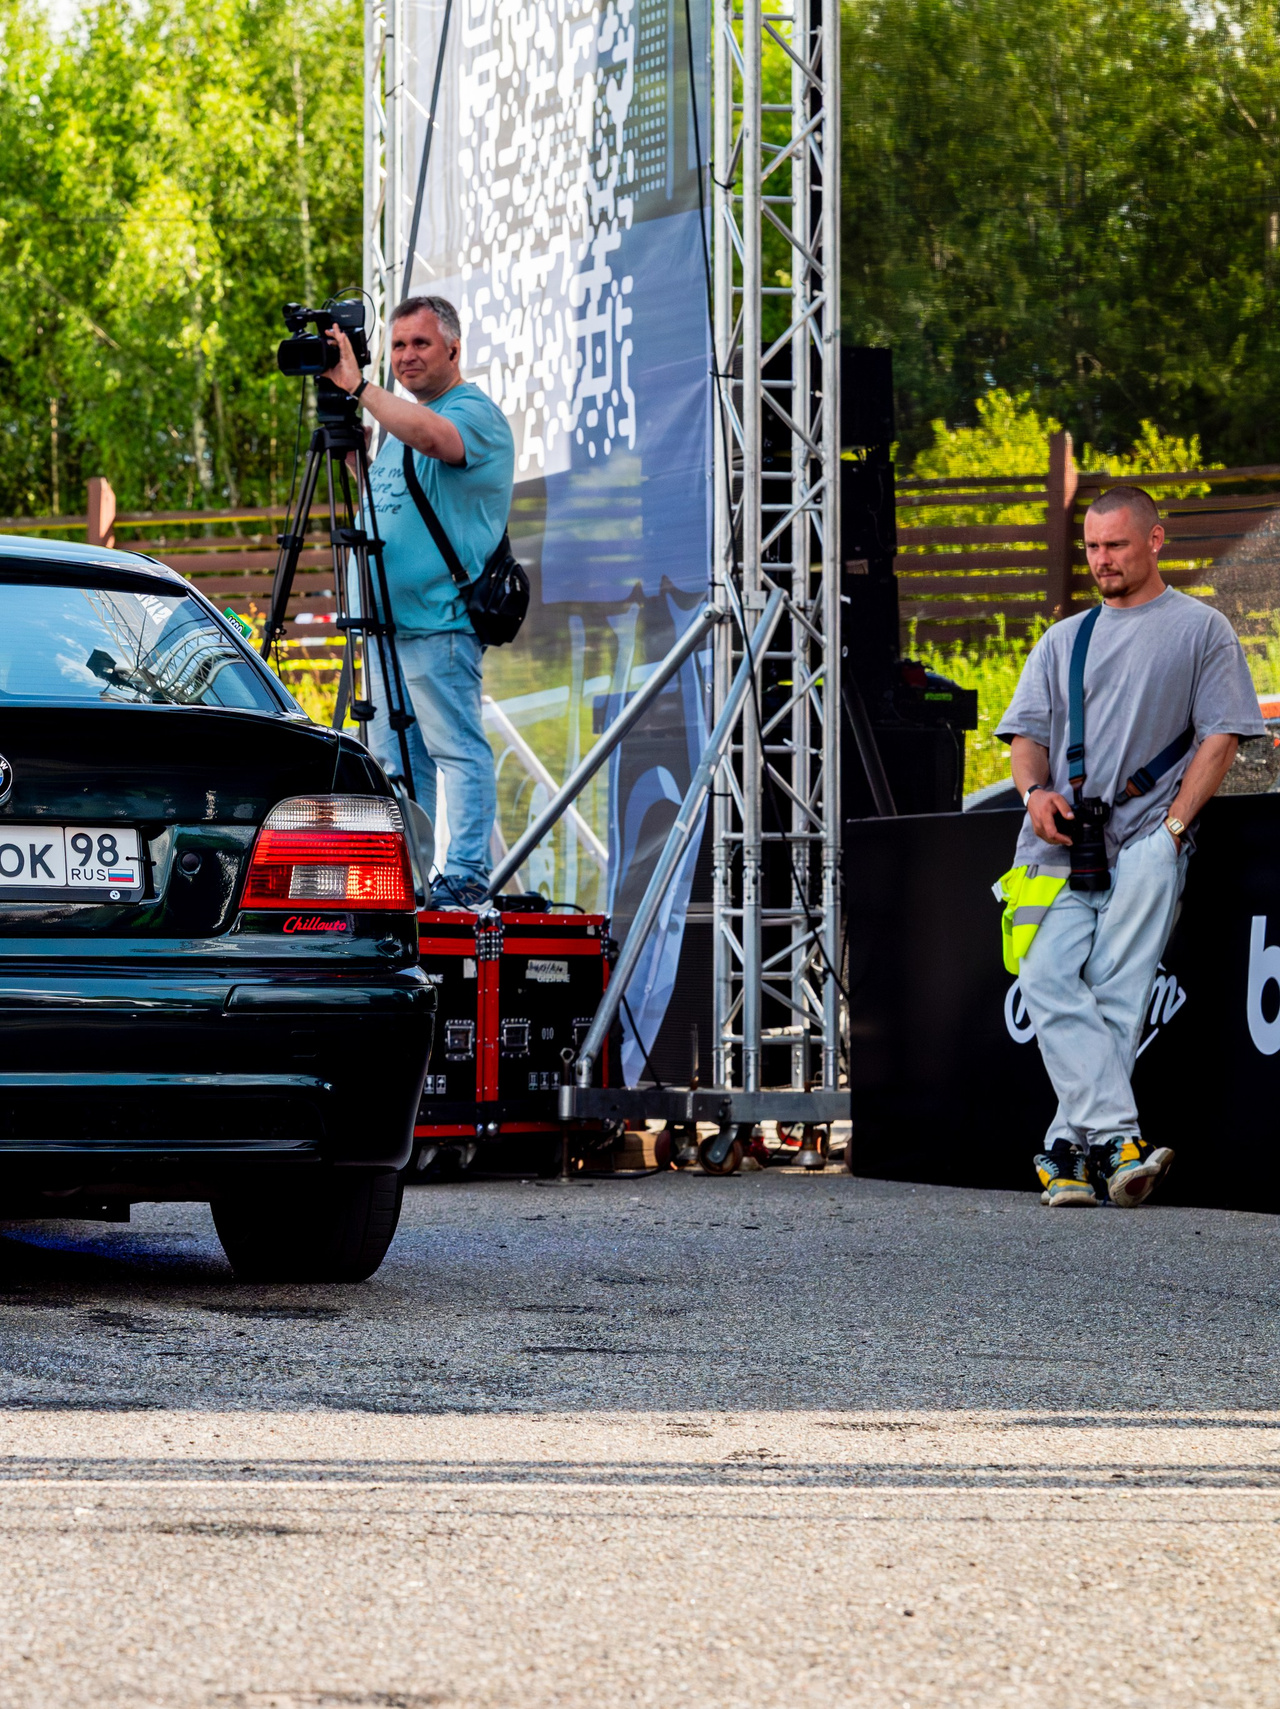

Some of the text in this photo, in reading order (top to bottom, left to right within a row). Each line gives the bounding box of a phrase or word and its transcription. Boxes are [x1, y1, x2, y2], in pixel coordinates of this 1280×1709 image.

[70, 832, 120, 867] 98
[71, 867, 107, 882] RUS
[282, 915, 347, 934] Chillauto
